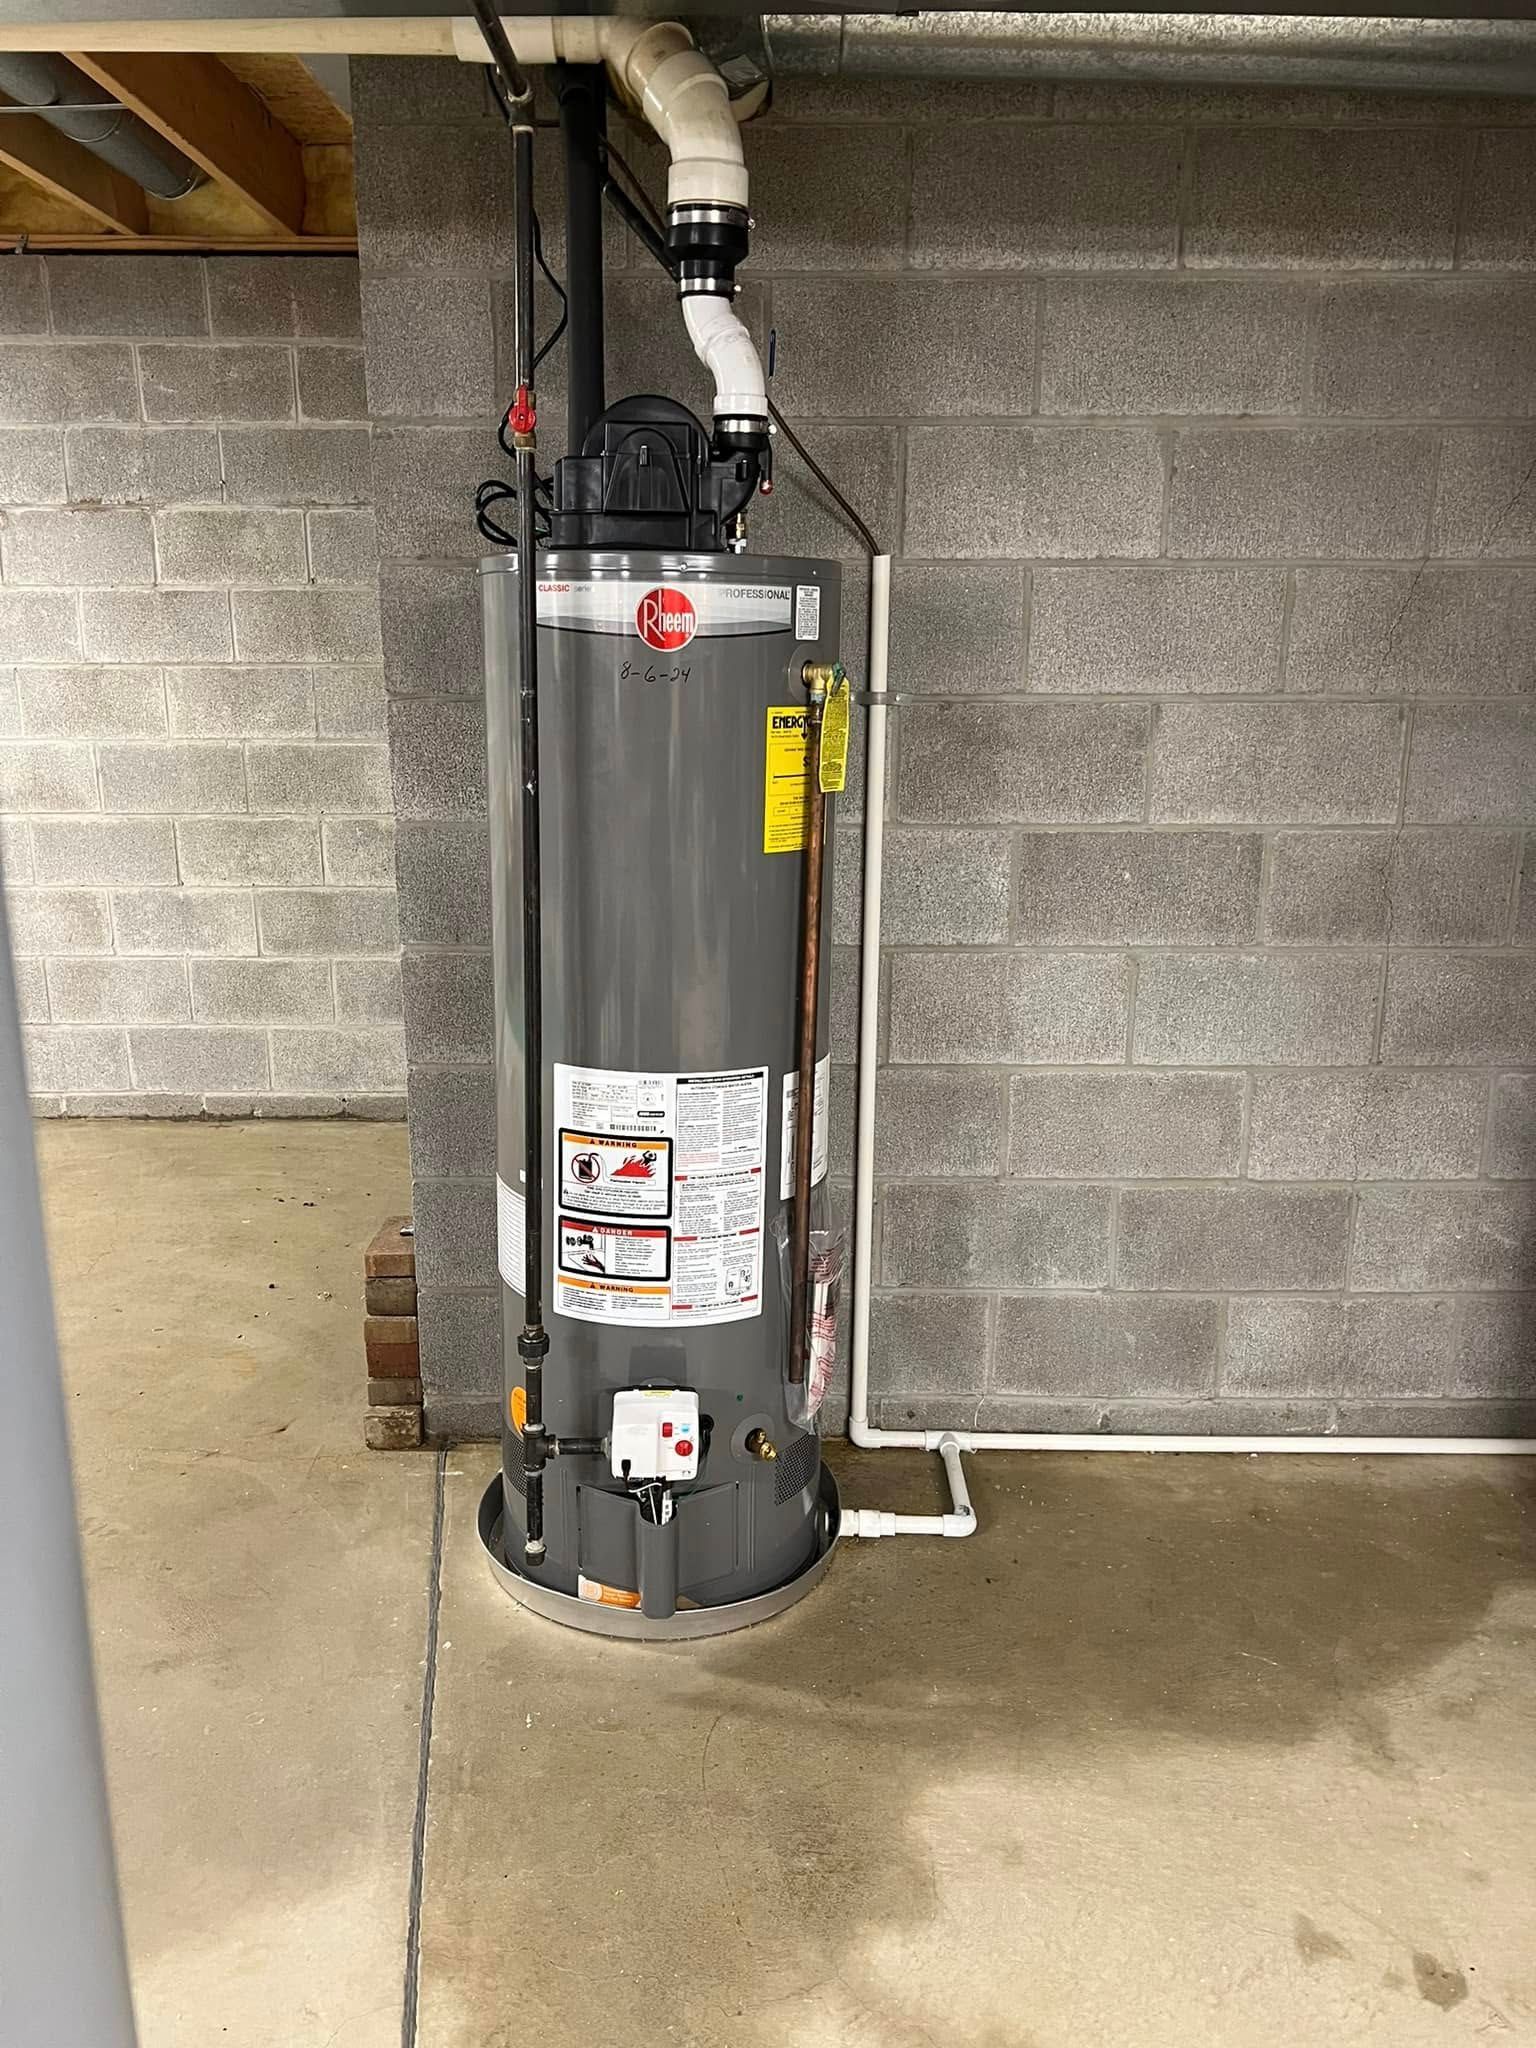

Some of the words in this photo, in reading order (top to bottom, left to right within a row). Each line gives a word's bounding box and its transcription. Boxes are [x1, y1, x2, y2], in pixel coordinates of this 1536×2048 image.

[538, 584, 570, 592] CLASSIC
[720, 588, 790, 600] PROFESSIONAL
[643, 589, 694, 641] Rheem
[620, 661, 691, 683] 8-6-24
[599, 1140, 638, 1148] WARNING
[600, 1227, 633, 1236] DANGER
[599, 1284, 634, 1293] WARNING
